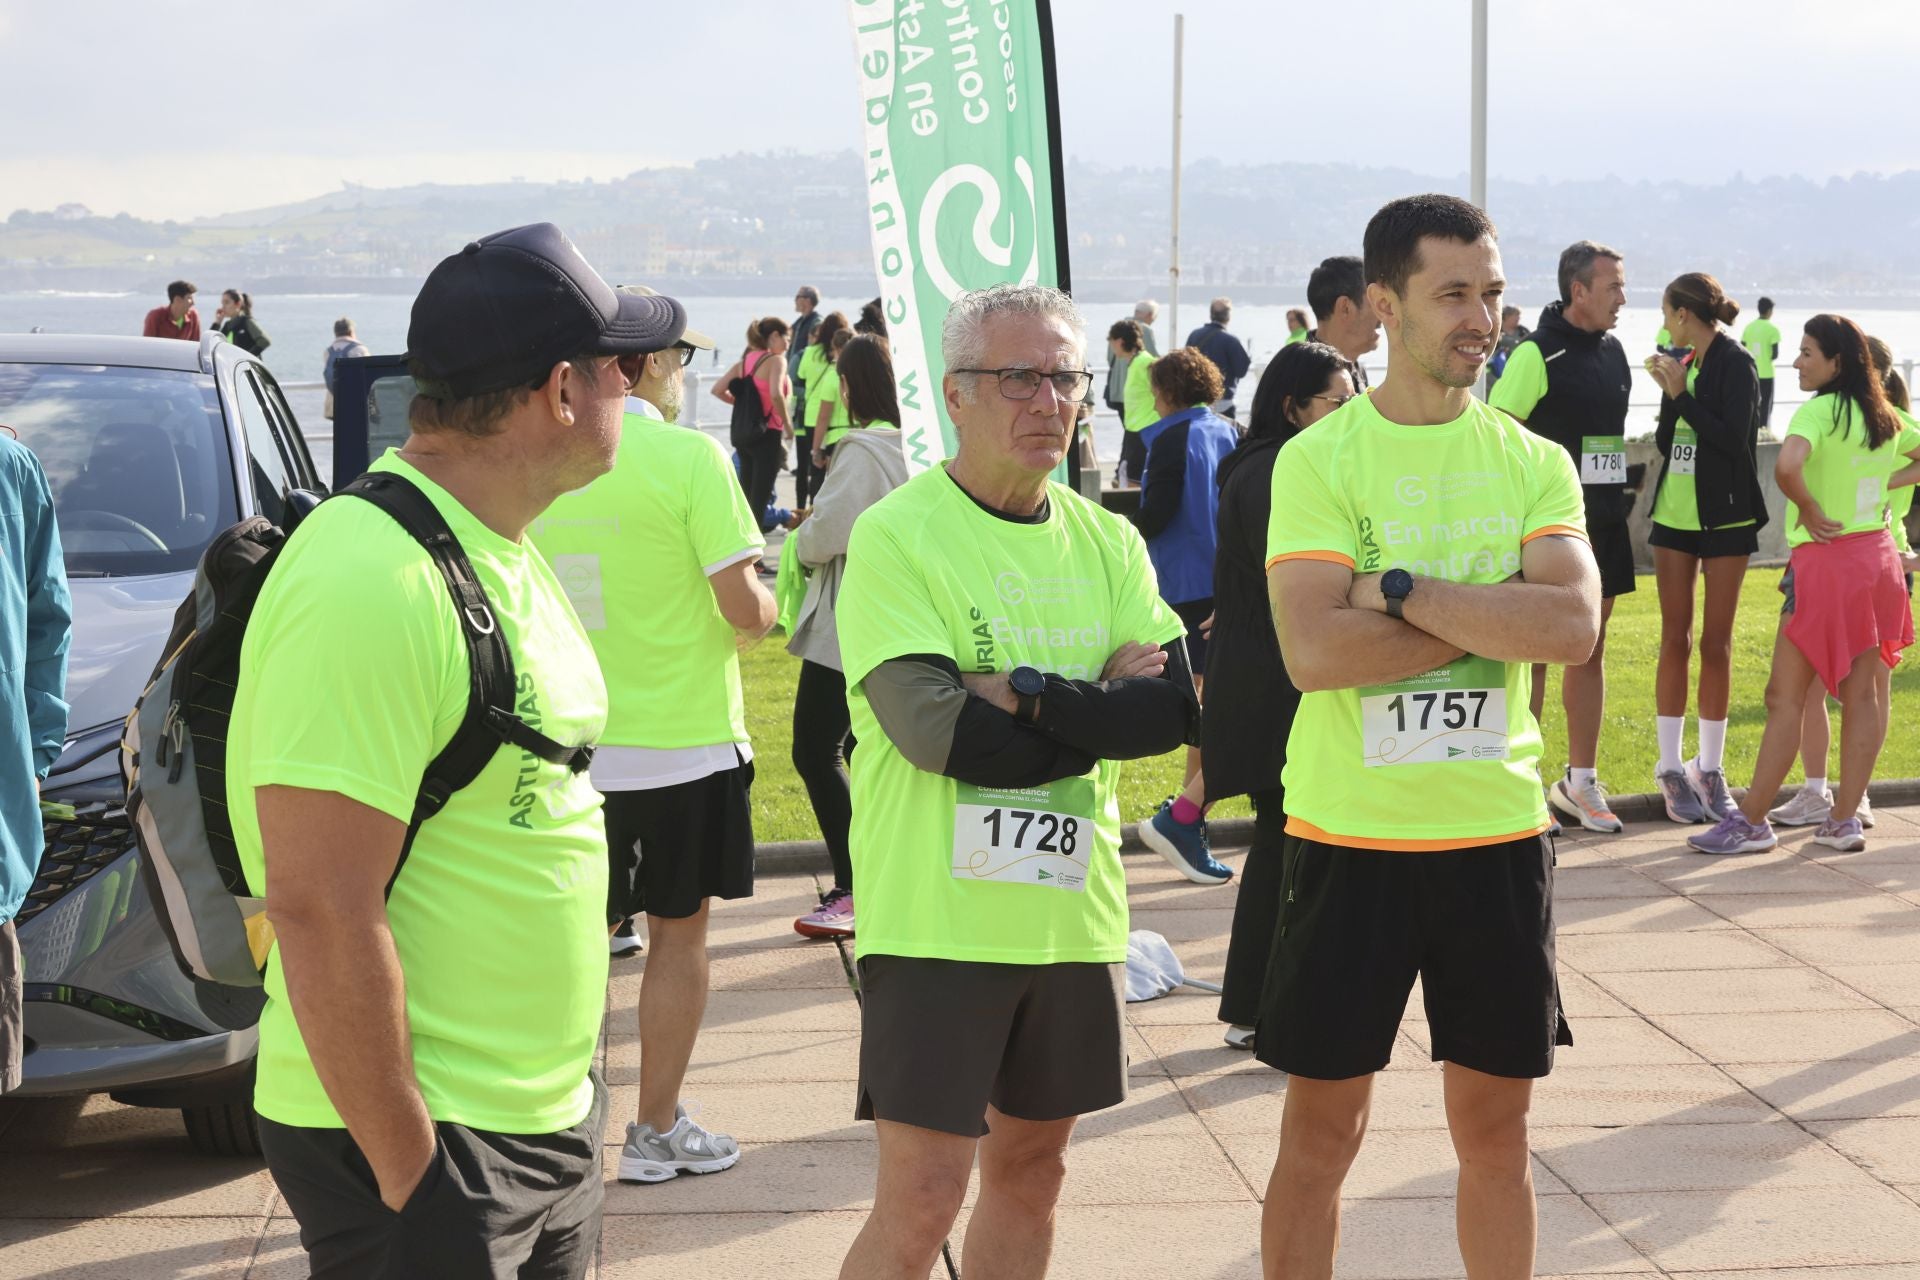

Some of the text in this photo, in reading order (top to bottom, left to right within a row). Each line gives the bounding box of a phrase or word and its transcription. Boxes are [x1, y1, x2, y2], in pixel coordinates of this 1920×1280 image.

[1591, 454, 1622, 470] 1780
[1383, 520, 1423, 545] En
[1387, 691, 1488, 732] 1757
[509, 672, 542, 830] ASTUIAS
[983, 808, 1078, 856] 1728
